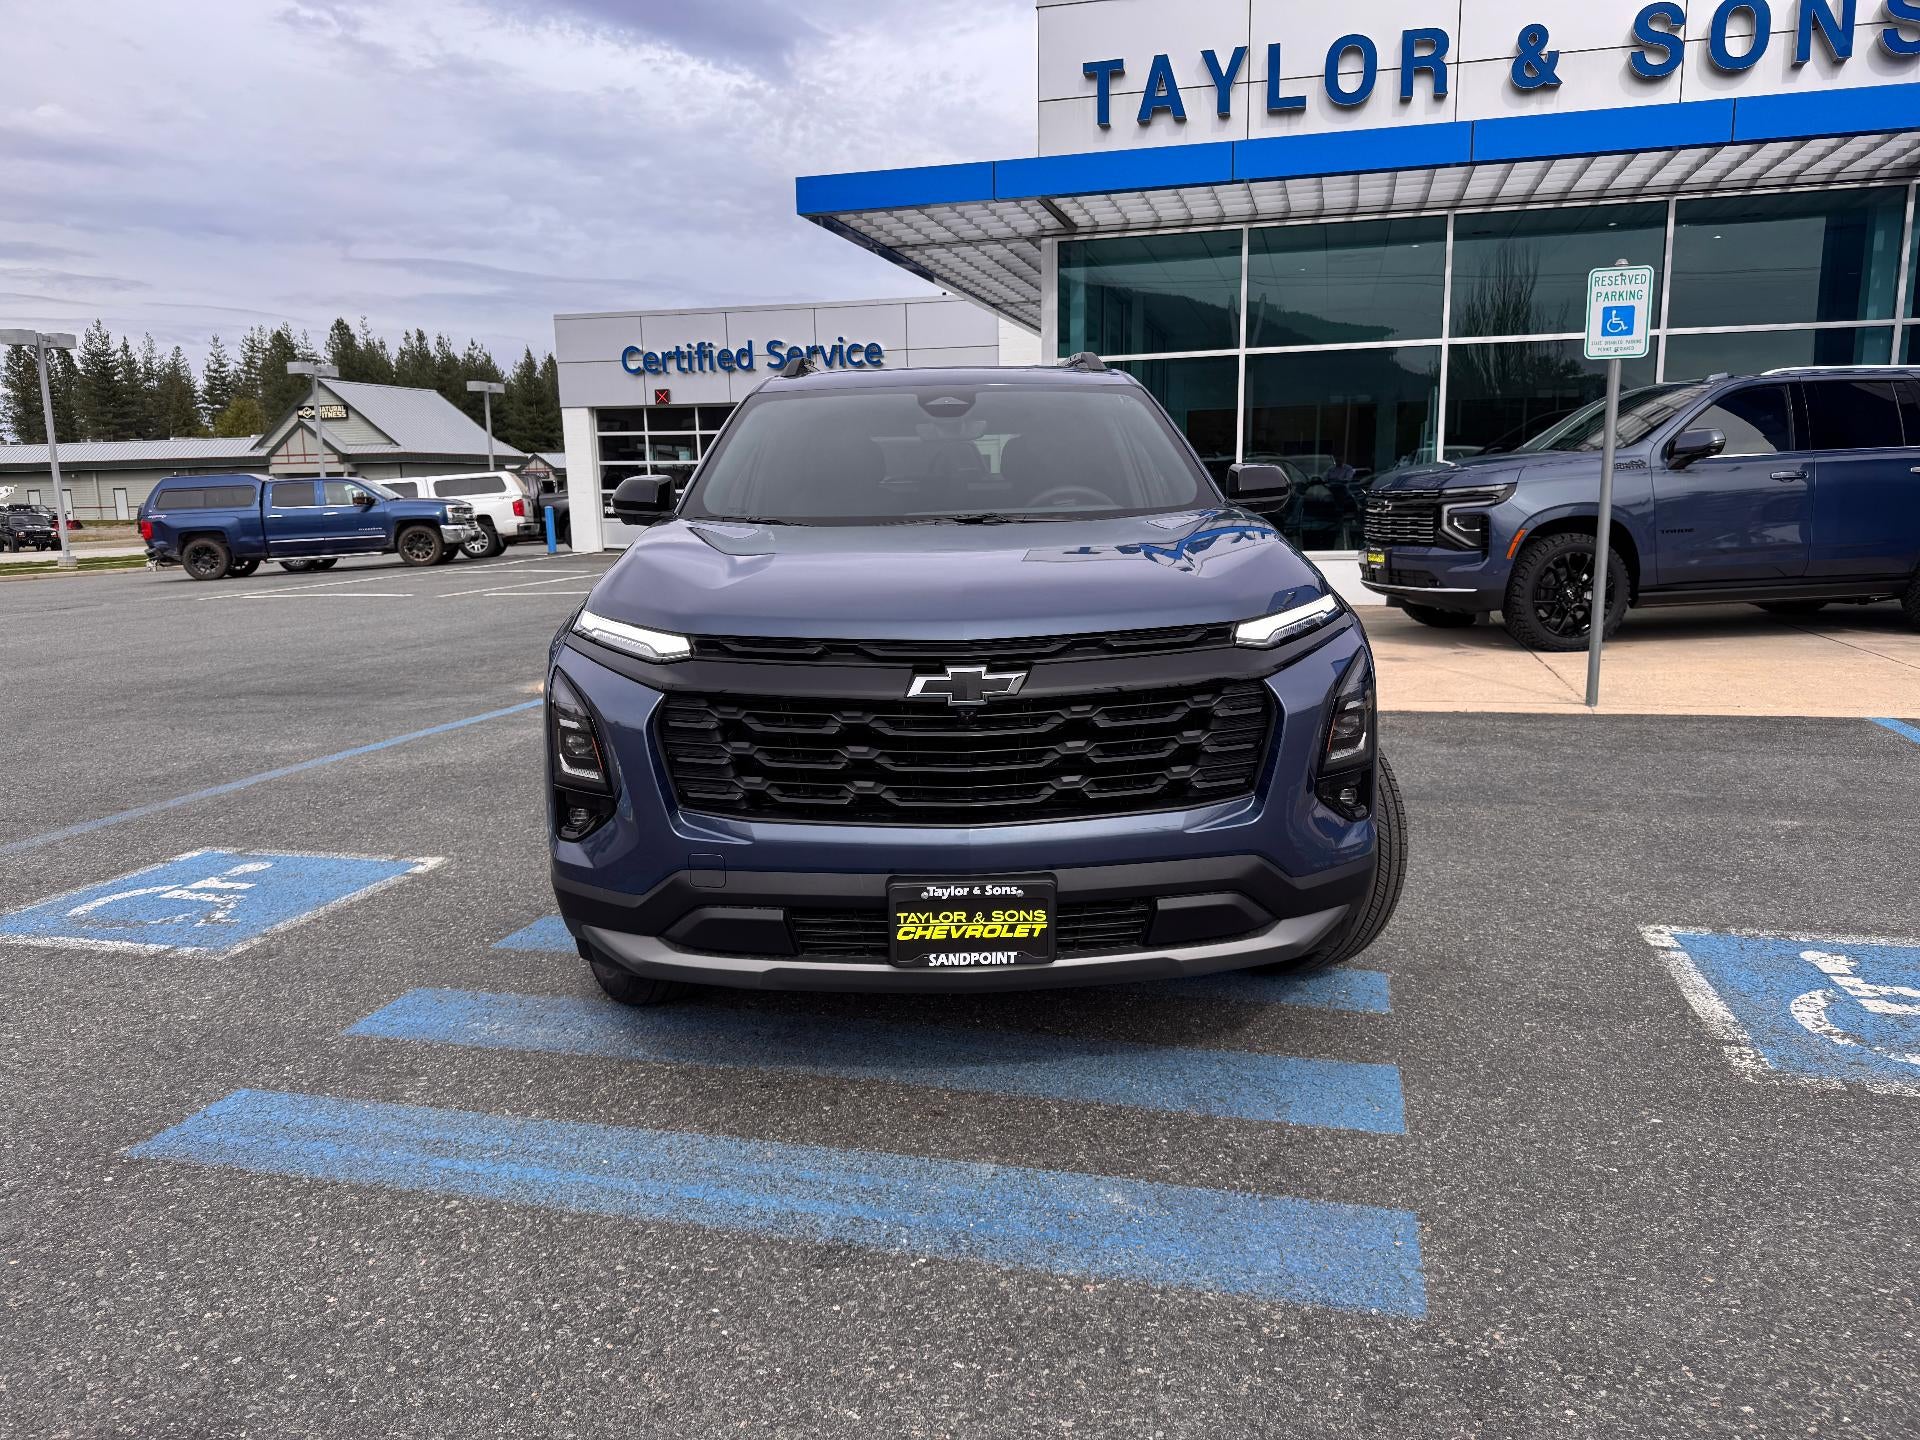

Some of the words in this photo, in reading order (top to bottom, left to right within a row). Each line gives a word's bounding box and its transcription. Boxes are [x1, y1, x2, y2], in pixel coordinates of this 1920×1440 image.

[1082, 26, 1450, 128] TAYLOR
[1510, 23, 1563, 91] &
[1594, 273, 1646, 287] RESERVED
[1596, 290, 1643, 302] PARKING
[621, 340, 755, 375] Certified
[766, 336, 884, 370] Service
[927, 886, 970, 900] Taylor
[972, 887, 982, 895] &
[984, 885, 1018, 896] Sons
[896, 912, 966, 924] TAYLOR
[972, 911, 986, 925] &
[991, 910, 1046, 922] SONS
[896, 925, 1048, 941] CHEVROLET
[928, 951, 1018, 967] SANDPOINT
